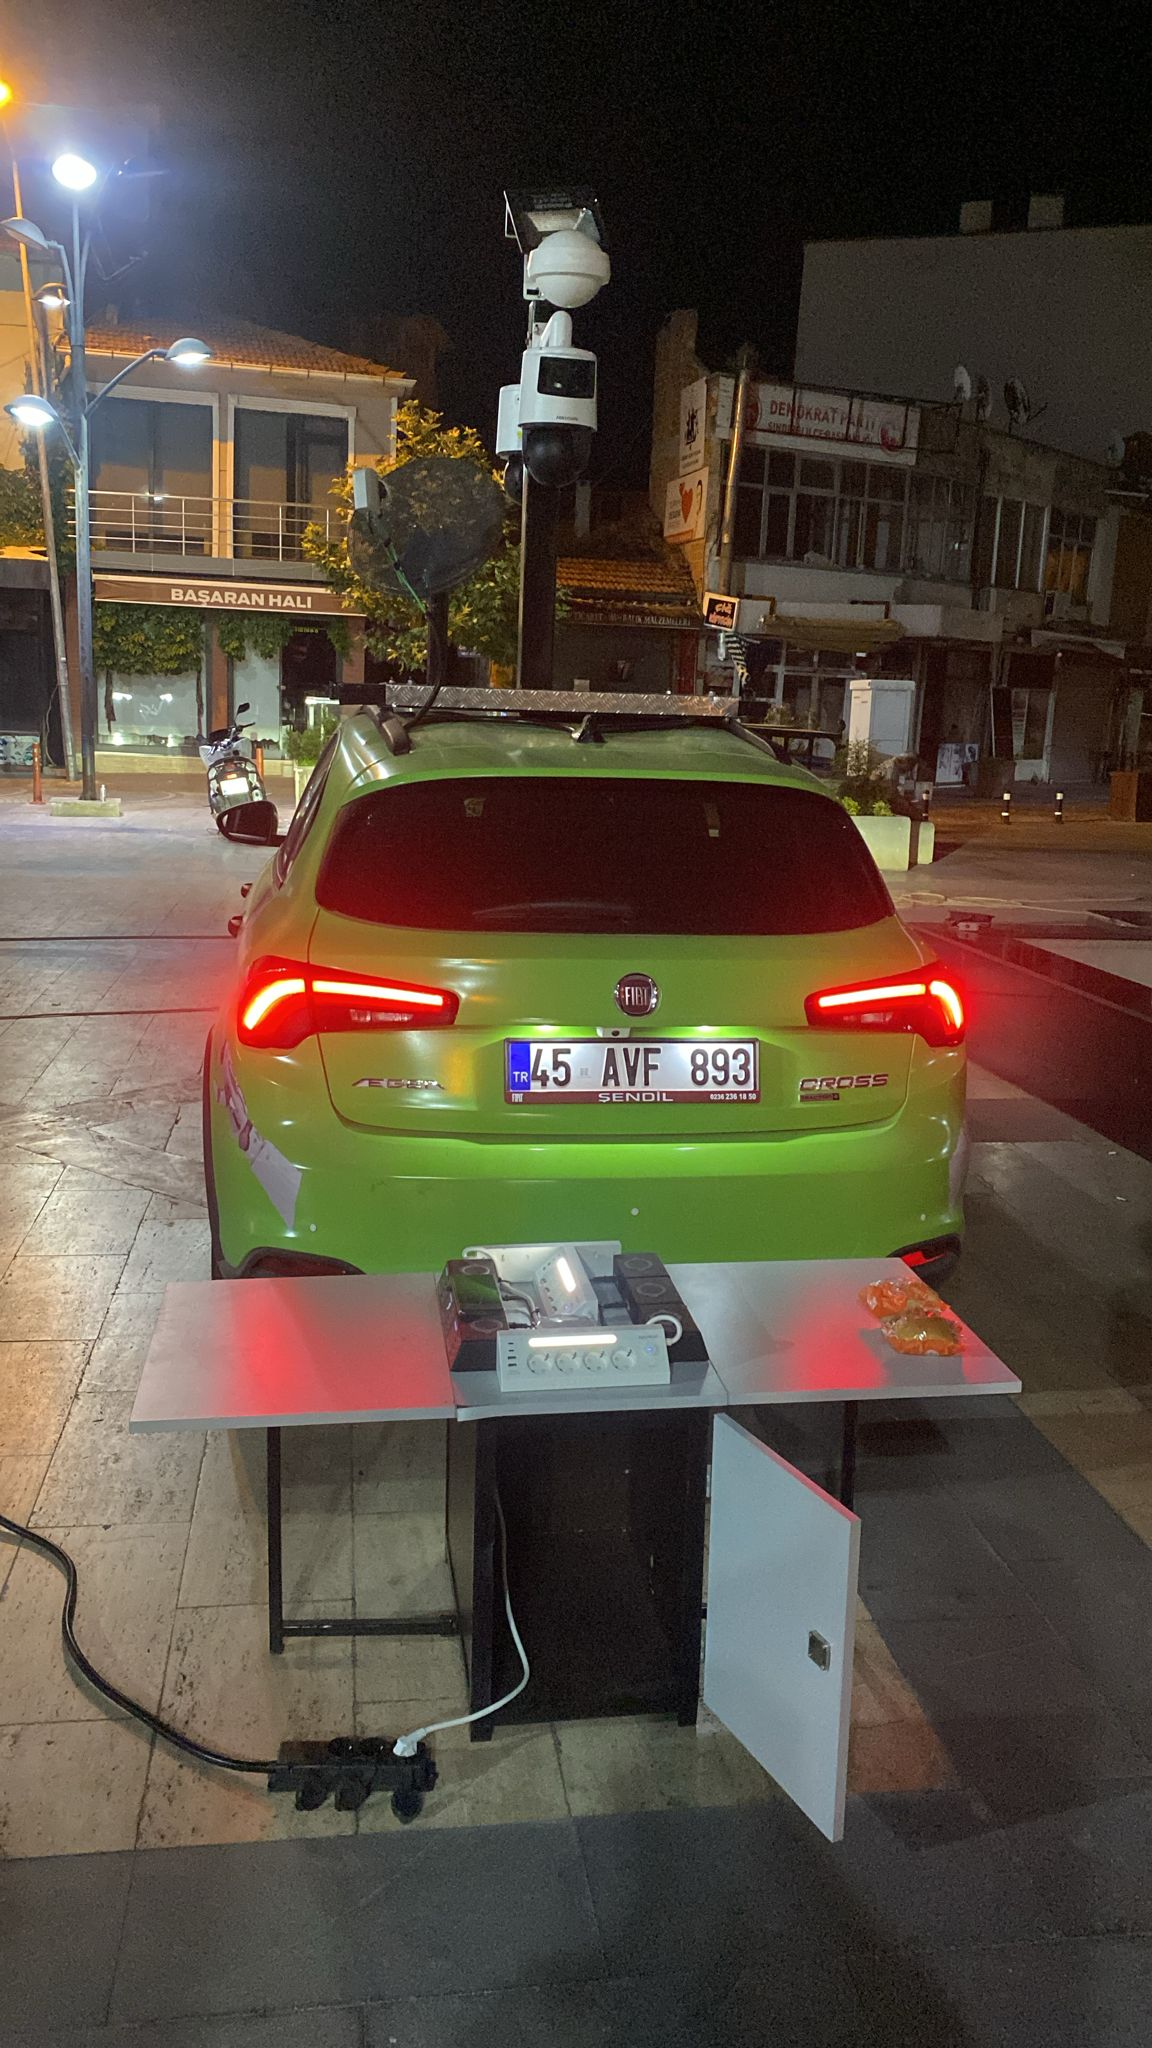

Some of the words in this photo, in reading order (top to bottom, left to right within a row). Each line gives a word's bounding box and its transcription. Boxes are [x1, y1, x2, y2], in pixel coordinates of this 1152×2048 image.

[170, 588, 265, 606] BAŞARAN
[268, 594, 312, 608] HALI
[624, 986, 649, 1006] FIAT
[531, 1048, 571, 1087] 45
[602, 1047, 661, 1087] AVF
[690, 1048, 750, 1086] 893
[513, 1071, 528, 1083] TR
[799, 1073, 888, 1091] CROSS
[709, 1093, 725, 1101] 0236
[725, 1093, 738, 1101] 236
[739, 1093, 747, 1101] 18
[748, 1093, 757, 1101] 50
